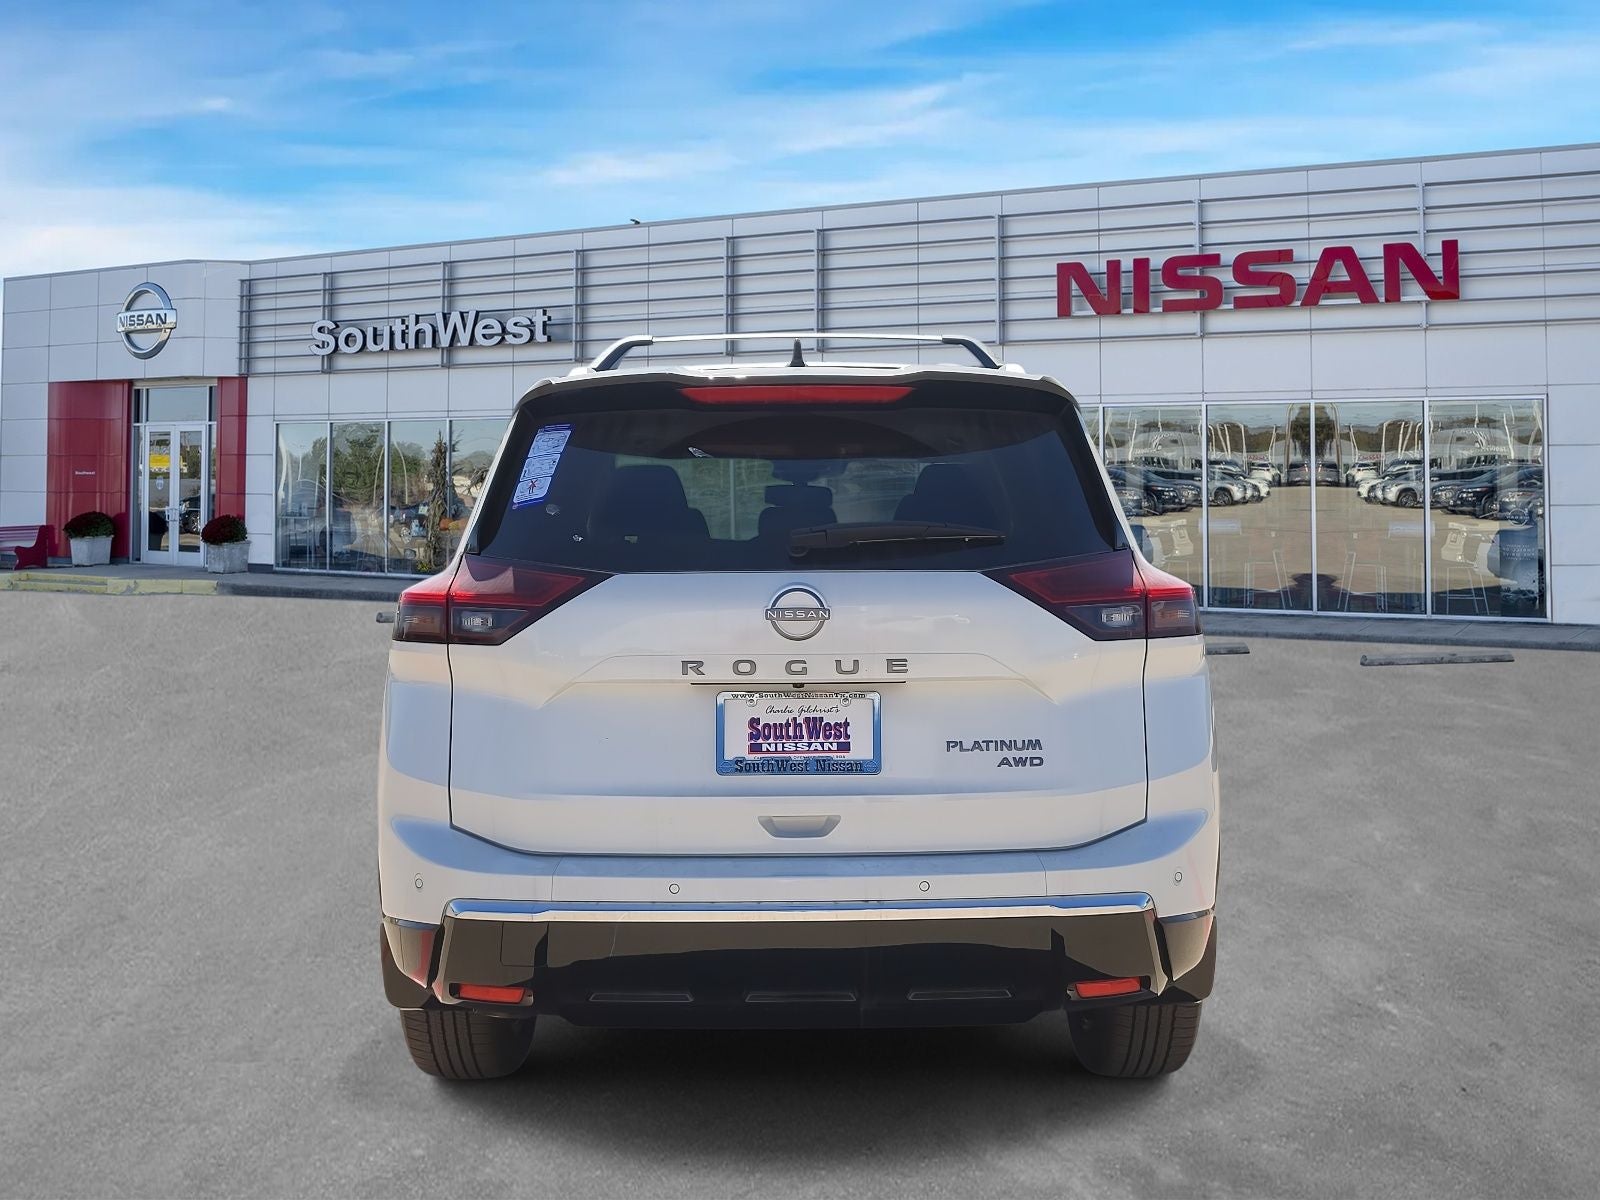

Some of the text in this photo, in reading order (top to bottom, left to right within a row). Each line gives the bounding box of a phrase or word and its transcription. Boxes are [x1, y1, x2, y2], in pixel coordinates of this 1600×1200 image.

[1056, 239, 1461, 318] NISSAN
[119, 312, 167, 328] NISSAN
[309, 308, 551, 356] SouthWest
[767, 610, 829, 618] NISSAN
[681, 658, 908, 676] ROGUE
[765, 705, 794, 714] Charlie
[748, 716, 850, 742] SouthWest
[761, 742, 838, 752] NISSAN
[946, 739, 1043, 752] PLATINUM
[735, 758, 863, 773] SouthWest Nissan
[997, 757, 1044, 767] AWD
